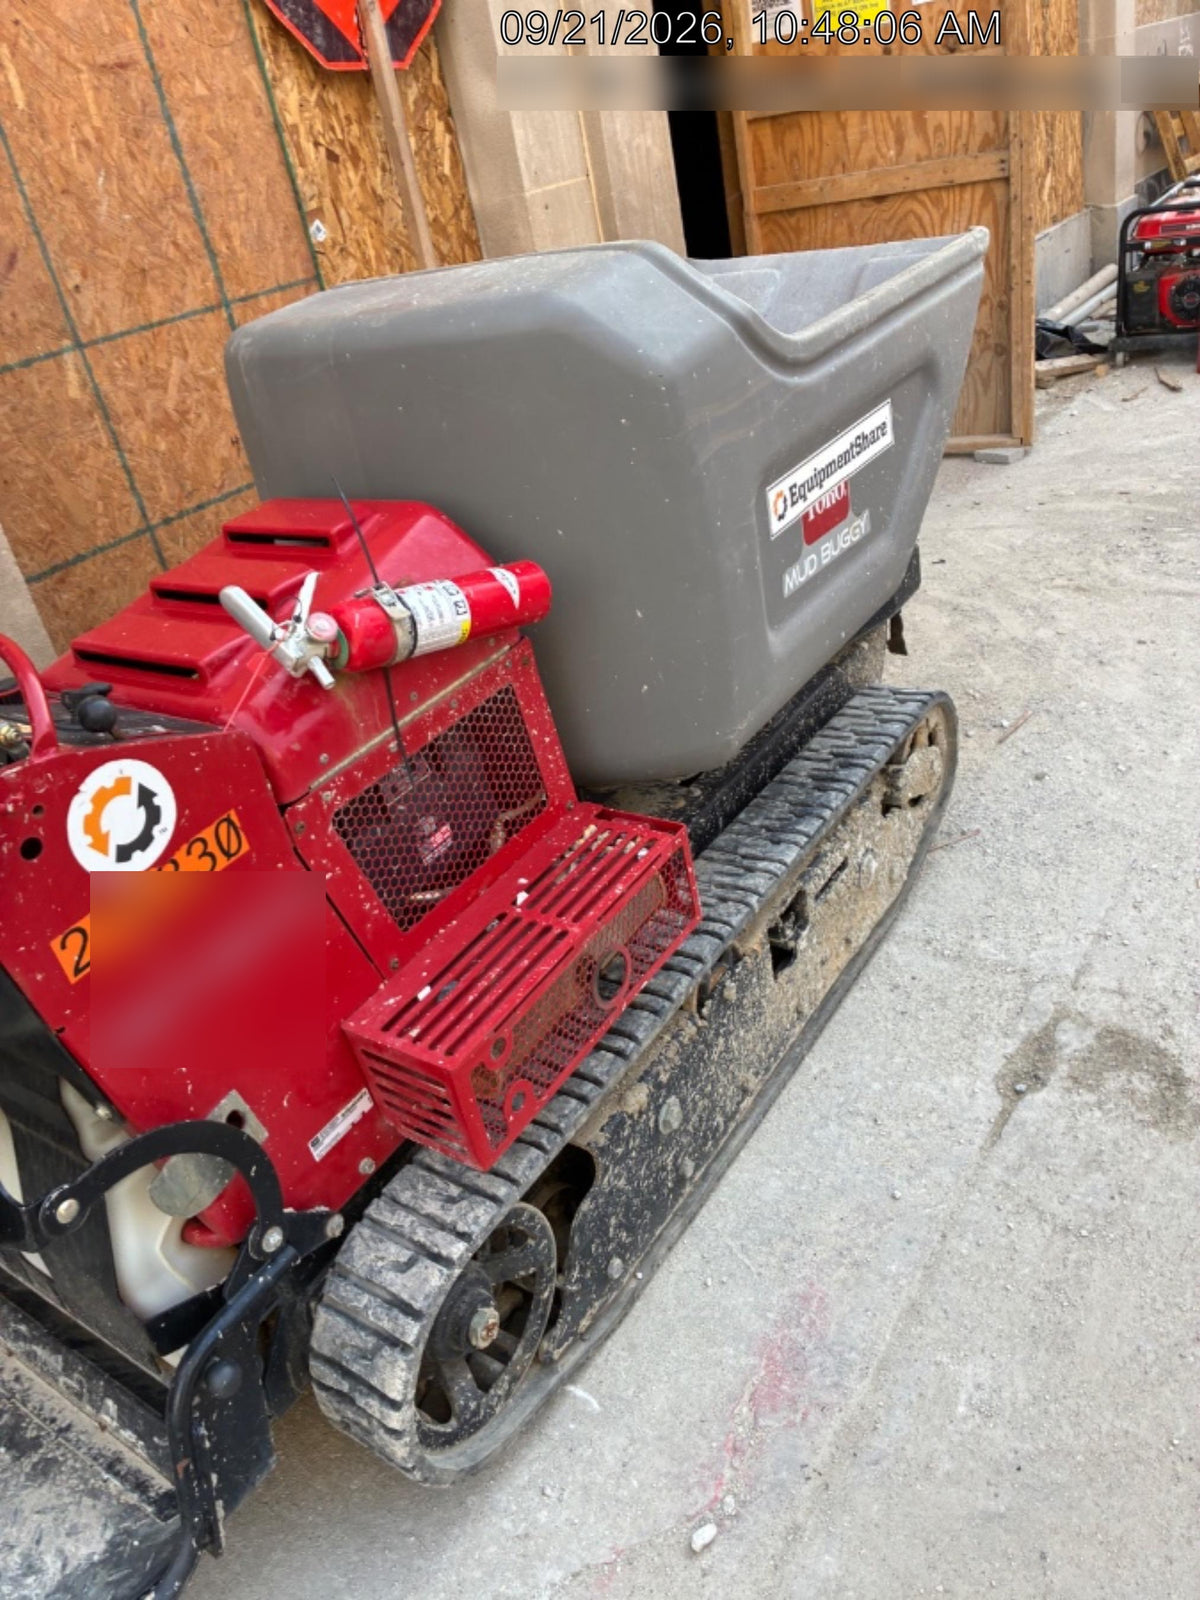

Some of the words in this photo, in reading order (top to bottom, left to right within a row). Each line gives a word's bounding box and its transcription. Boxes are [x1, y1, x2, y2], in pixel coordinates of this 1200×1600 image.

[788, 420, 888, 508] EquipmentShare
[784, 553, 817, 597] MUD
[820, 515, 869, 564] BUGGY
